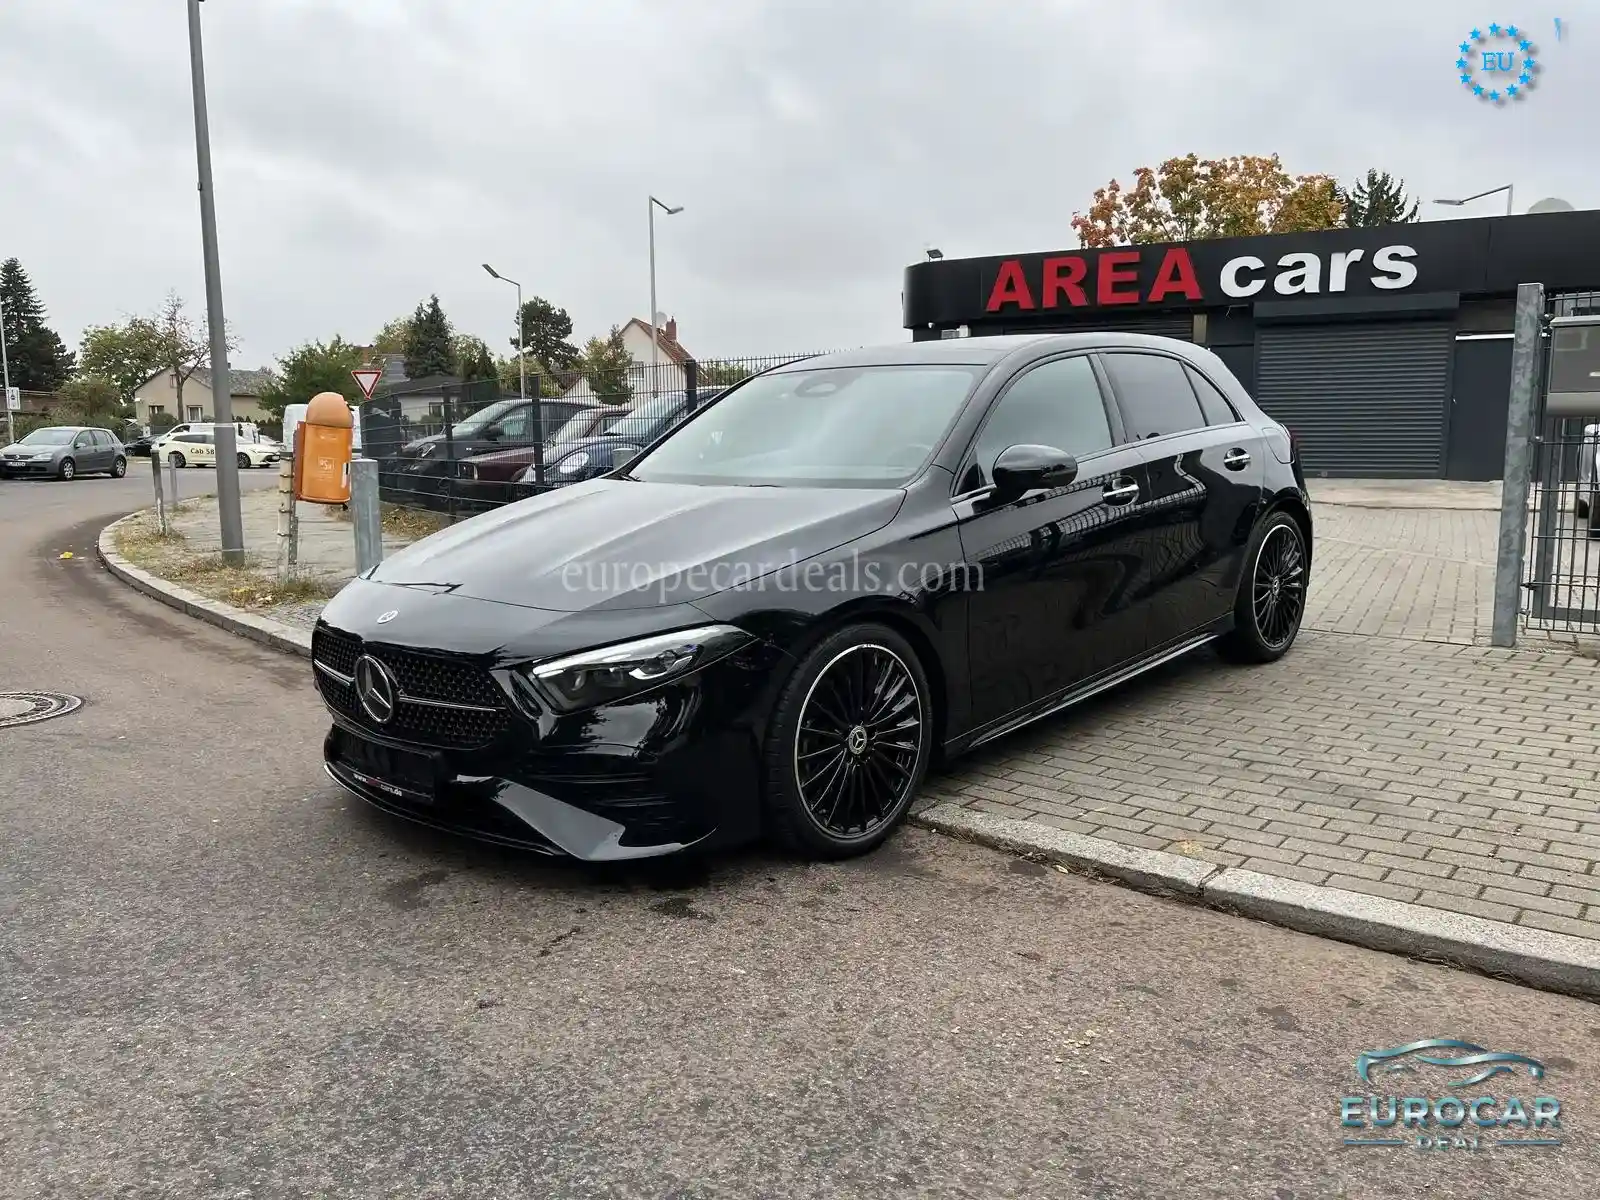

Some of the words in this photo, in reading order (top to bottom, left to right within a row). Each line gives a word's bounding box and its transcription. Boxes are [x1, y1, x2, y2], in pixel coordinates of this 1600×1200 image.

[986, 247, 1204, 312] AREA
[1219, 244, 1419, 298] cars
[190, 447, 204, 455] Cab
